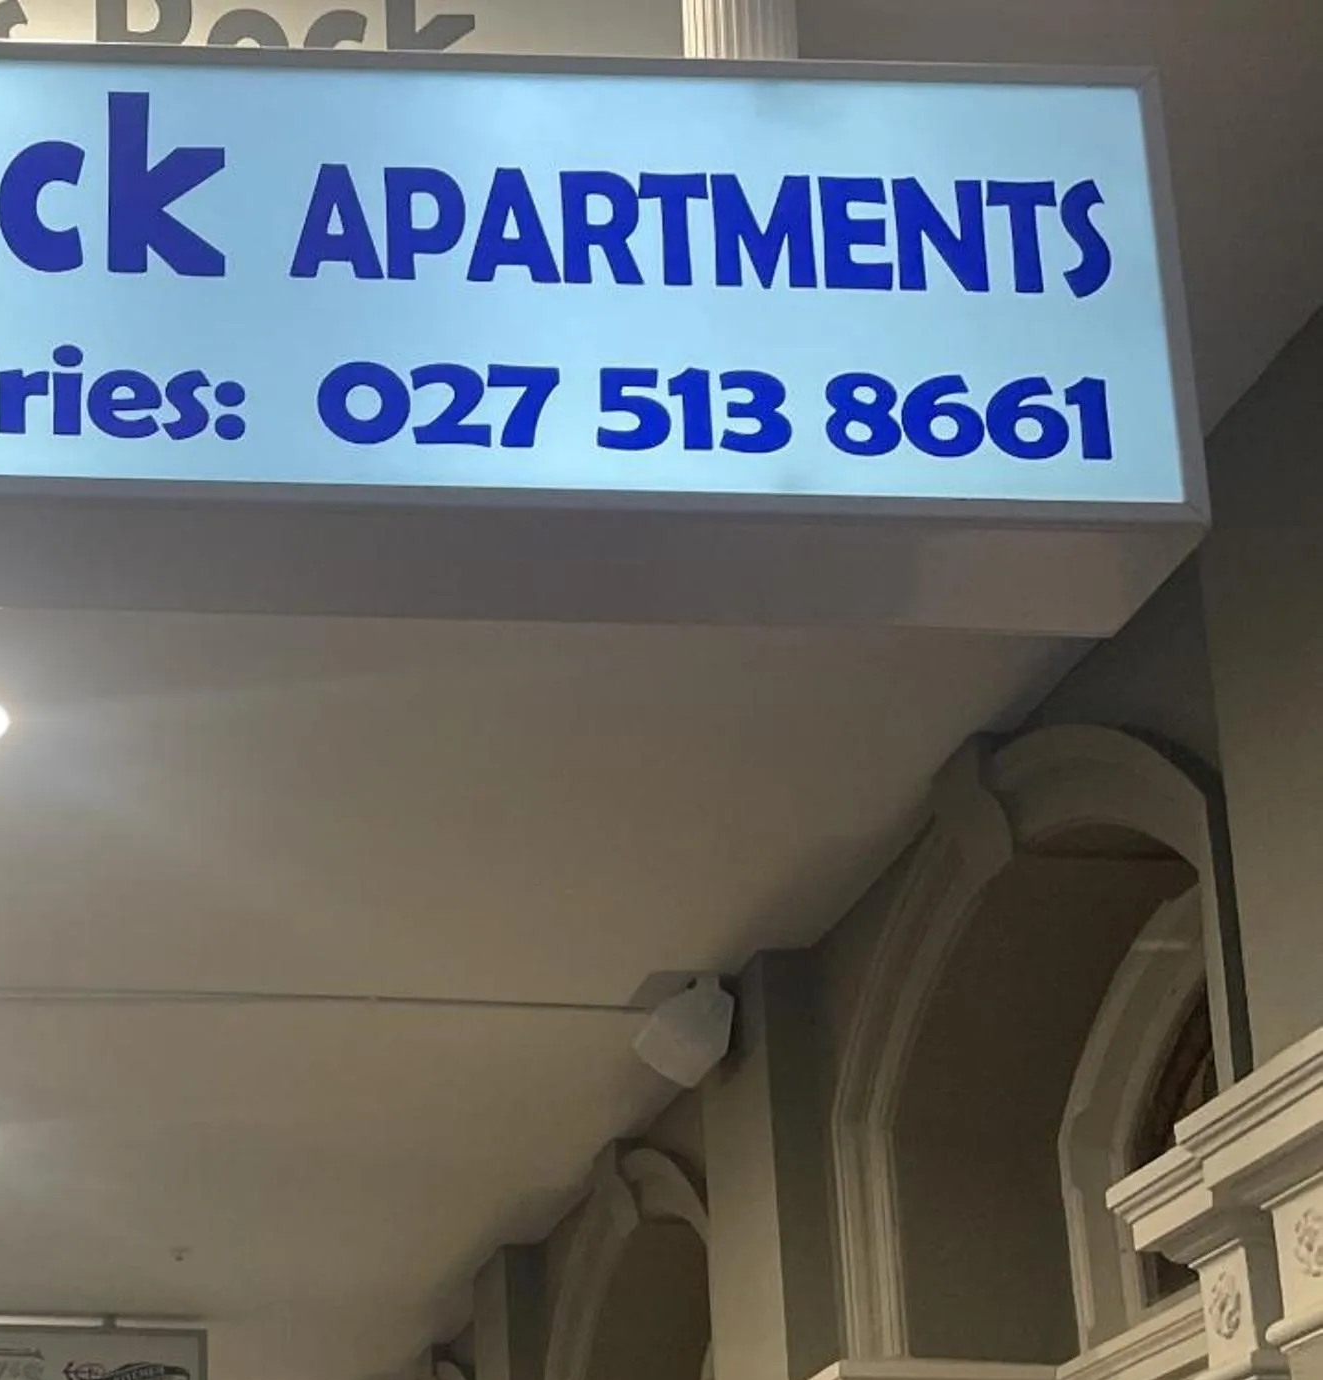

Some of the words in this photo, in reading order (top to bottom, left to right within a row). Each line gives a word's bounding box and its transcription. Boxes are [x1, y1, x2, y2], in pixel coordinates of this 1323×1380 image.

[289, 163, 1112, 298] APARTMENTS
[317, 361, 560, 448] 027
[596, 367, 793, 454] 513
[825, 372, 1113, 461] 8661
